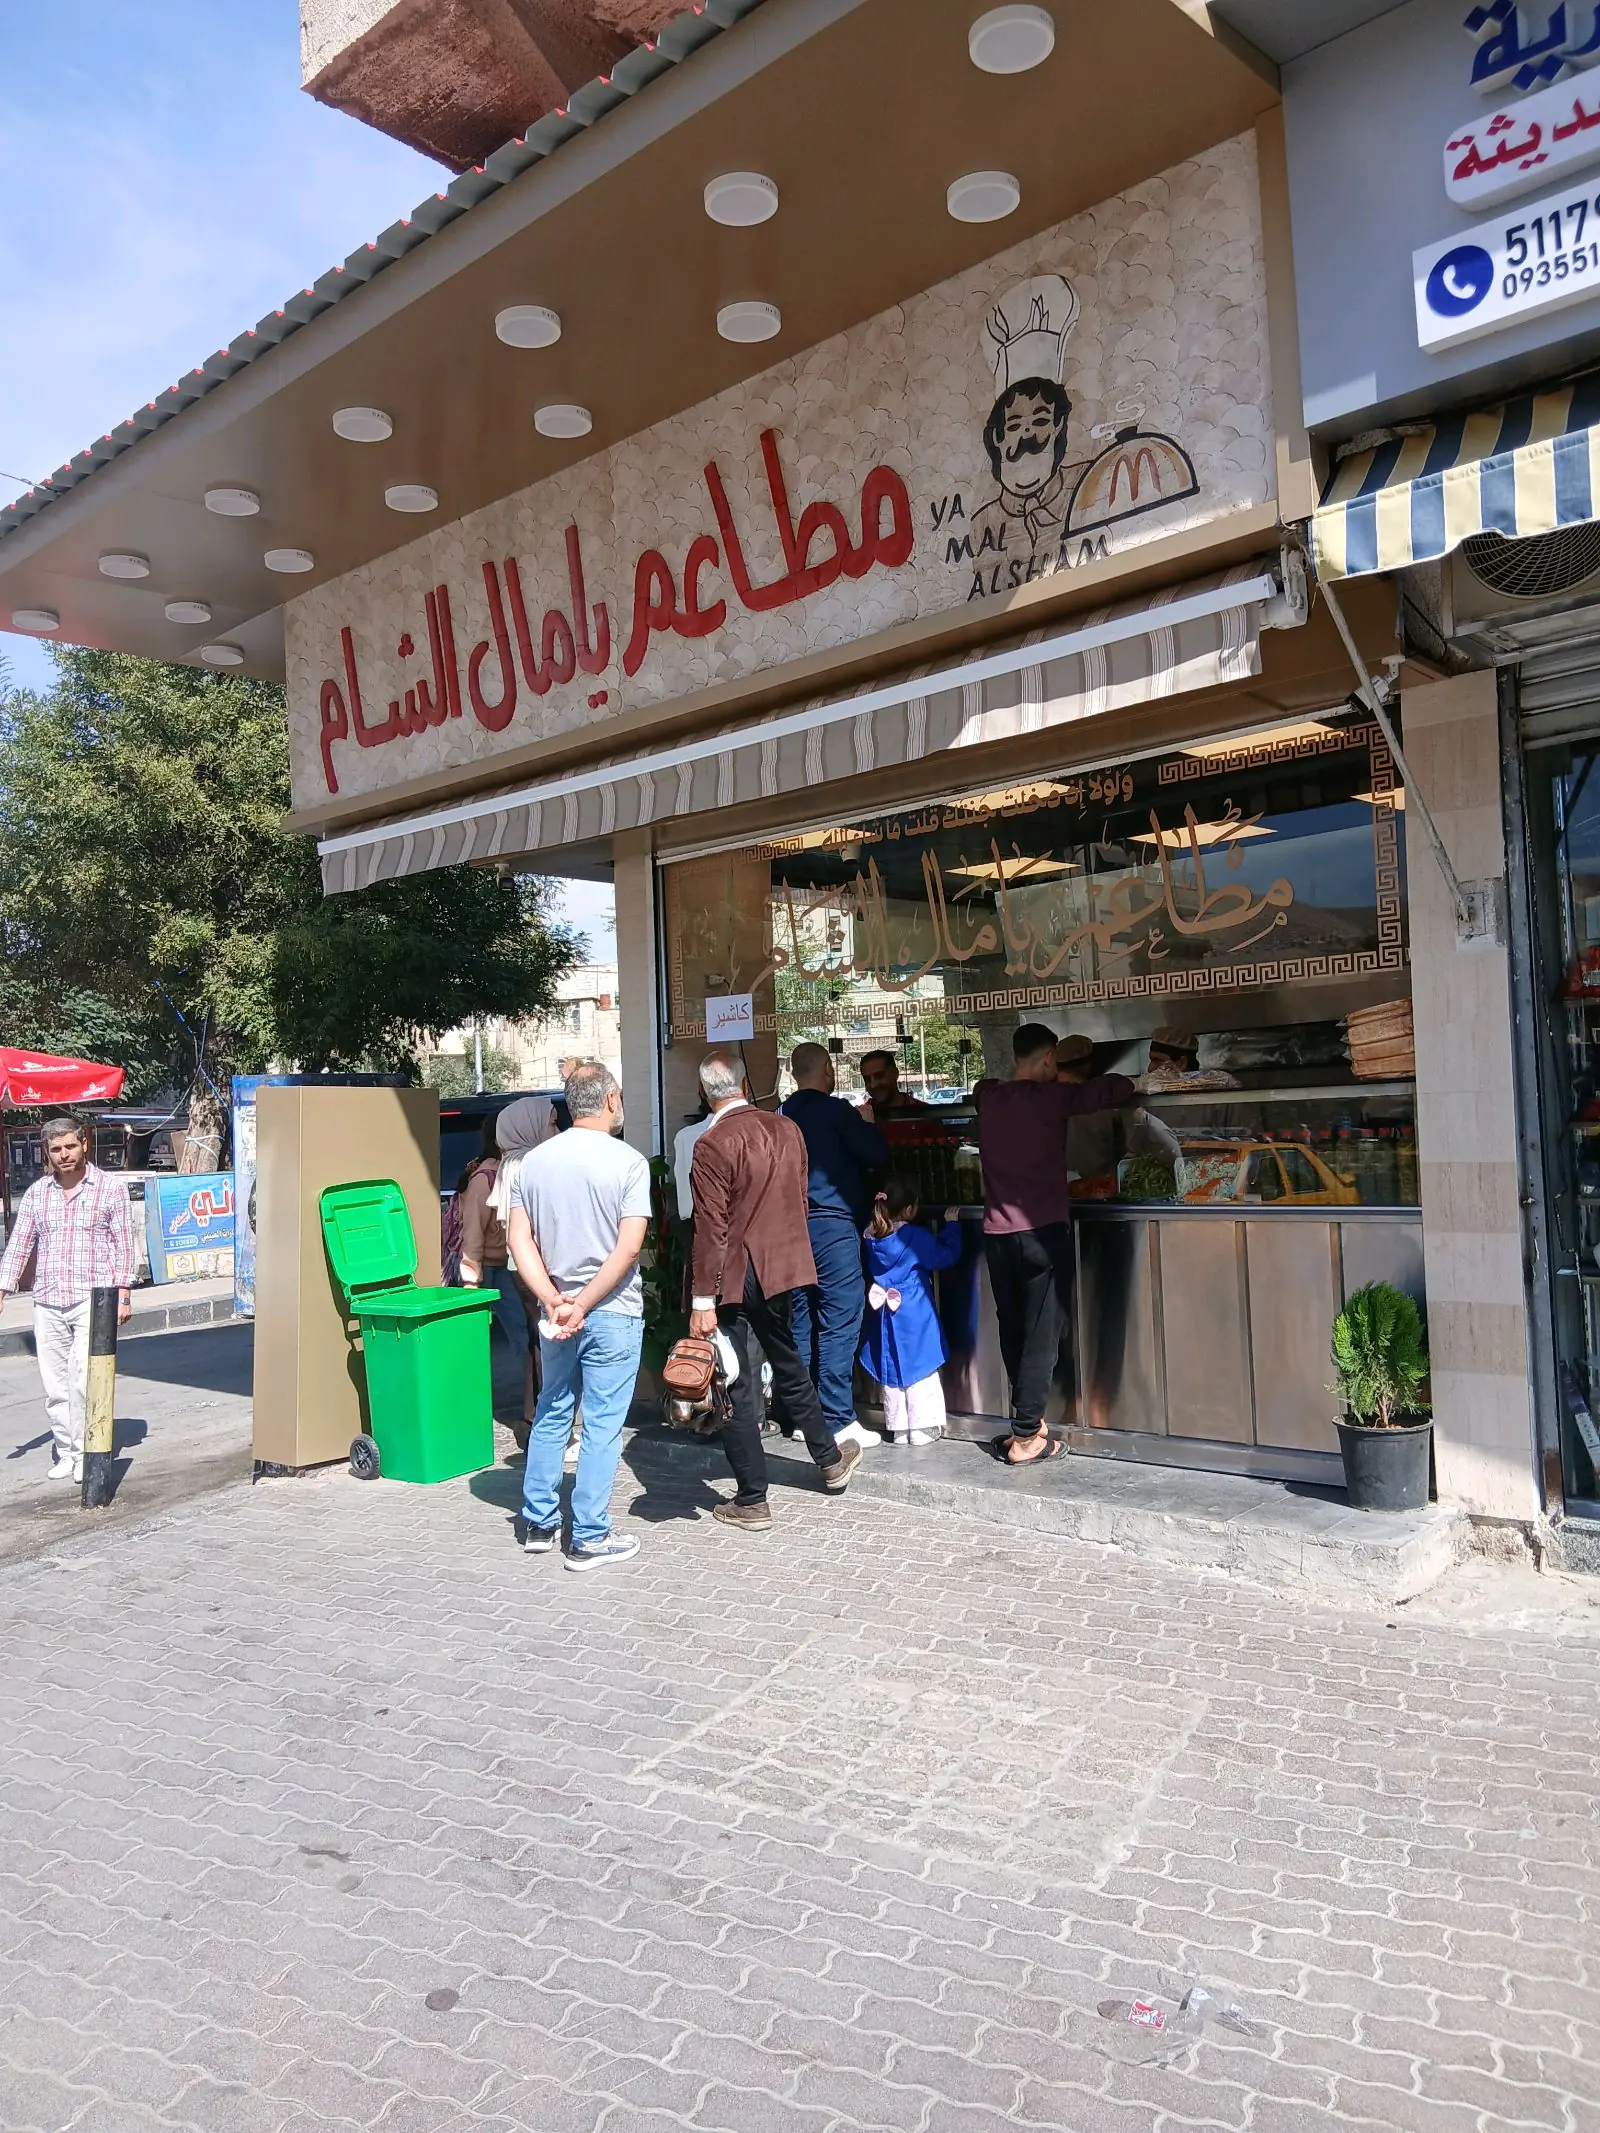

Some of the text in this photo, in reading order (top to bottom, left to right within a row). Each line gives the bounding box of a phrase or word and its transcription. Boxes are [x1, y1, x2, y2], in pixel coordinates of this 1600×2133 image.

[1446, 98, 1600, 181] ديثة
[1502, 242, 1599, 299] 093551
[930, 493, 966, 531] YA
[945, 522, 1009, 564] MAL
[623, 428, 915, 678] مطاعم
[967, 534, 1112, 601] ALSHAM
[319, 584, 462, 794] الشام
[1030, 800, 1295, 978] مطاعم
[711, 1001, 750, 1030] كاشير
